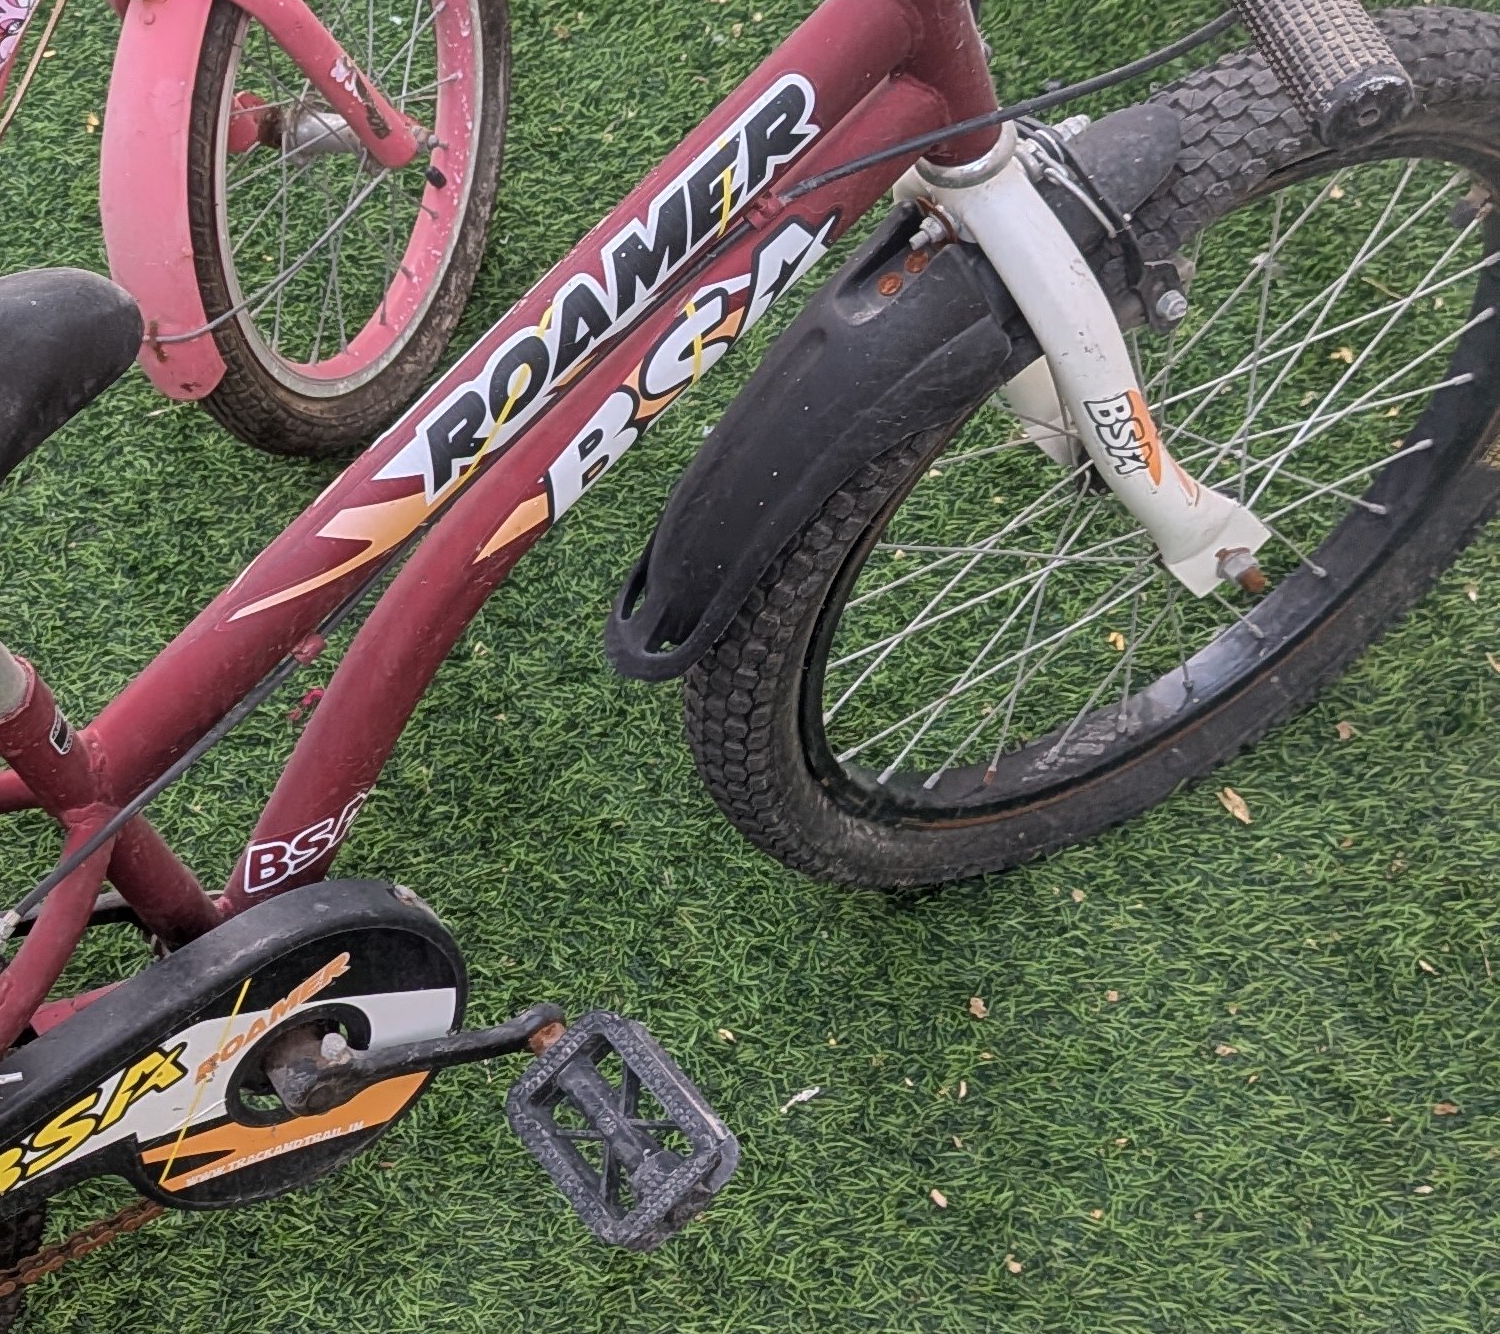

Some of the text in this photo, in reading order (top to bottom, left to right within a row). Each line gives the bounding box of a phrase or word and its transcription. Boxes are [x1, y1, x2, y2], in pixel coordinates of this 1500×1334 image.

[420, 75, 821, 504] ROAMER
[1083, 389, 1154, 476] BSA
[195, 951, 351, 1086] ROAMER
